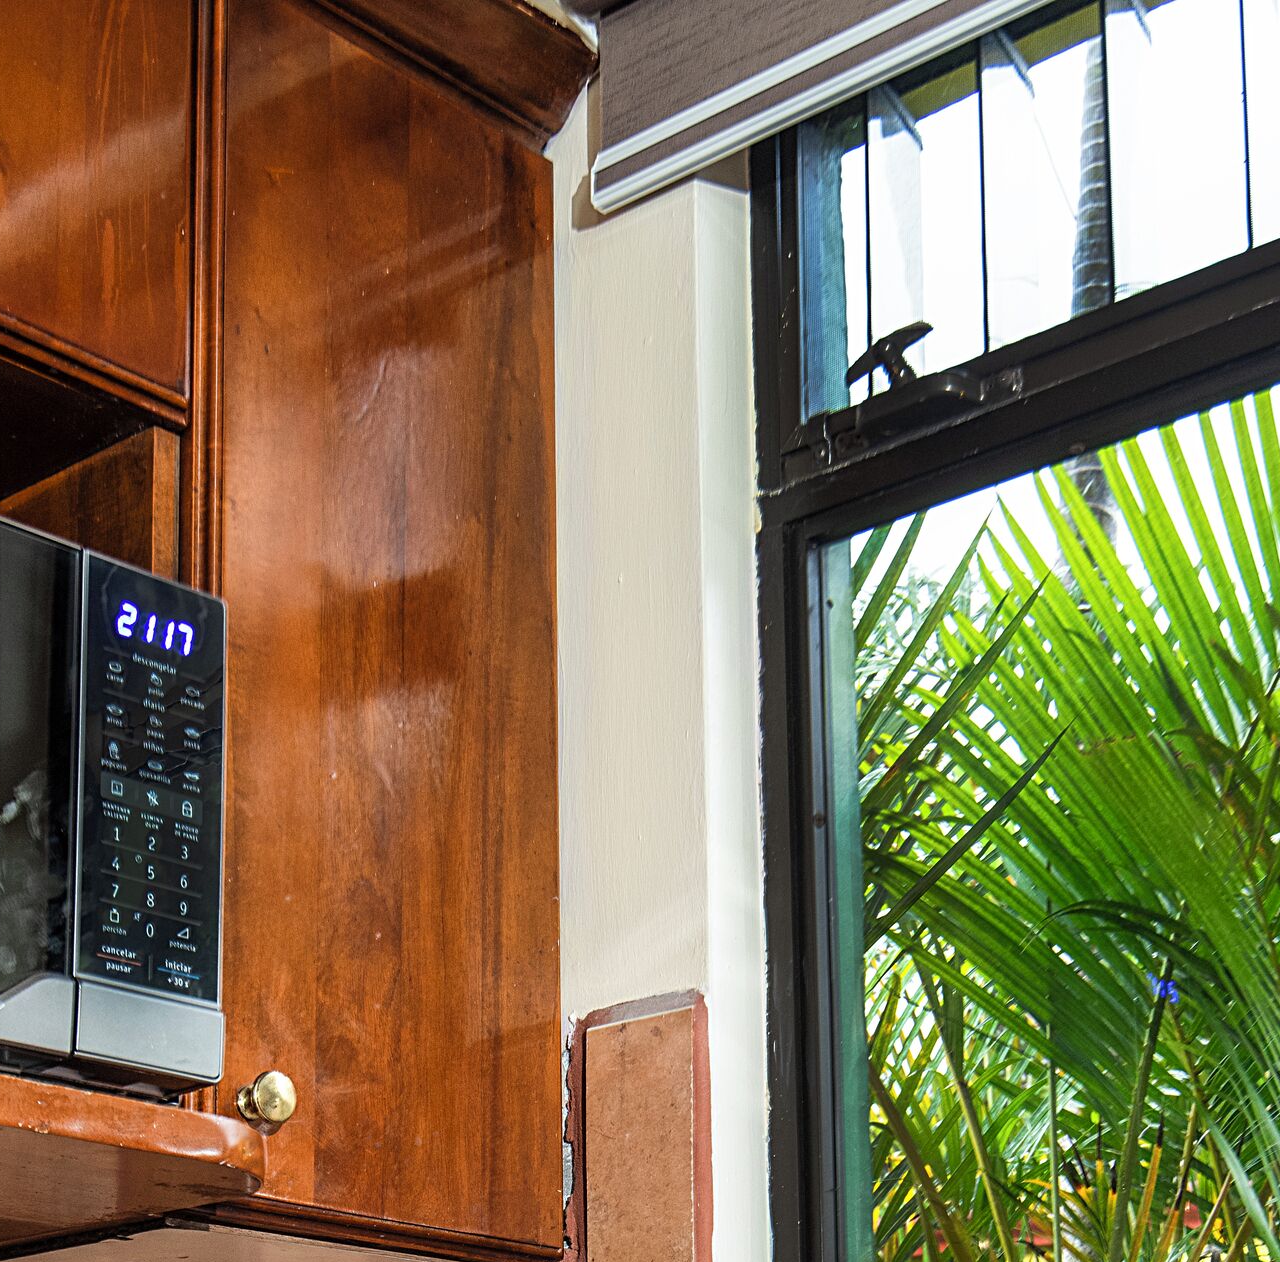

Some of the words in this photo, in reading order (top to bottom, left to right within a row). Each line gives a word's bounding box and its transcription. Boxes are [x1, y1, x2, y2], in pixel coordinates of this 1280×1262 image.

[116, 601, 194, 656] 2117
[132, 653, 177, 675] descongelar
[148, 687, 165, 698] pollo
[143, 698, 166, 713] diario
[180, 696, 205, 711] pescado
[143, 741, 164, 754] niños
[101, 757, 127, 771] popcorn
[138, 768, 171, 785] quesadilla
[102, 801, 131, 815] MANTENER
[103, 809, 129, 823] CALIENTE
[114, 826, 120, 842] 1
[148, 836, 156, 852] 2
[181, 845, 189, 861] 3
[111, 856, 120, 872] 4
[147, 865, 155, 881] 5
[180, 874, 188, 889] 6
[111, 883, 119, 898] 7
[146, 892, 155, 908] 8
[179, 901, 188, 916] 9
[102, 924, 128, 936] porción
[146, 923, 155, 938] 0
[101, 945, 137, 959] cancelar
[168, 939, 197, 953] potencia
[105, 961, 133, 975] pausar
[165, 958, 193, 974] iniciar
